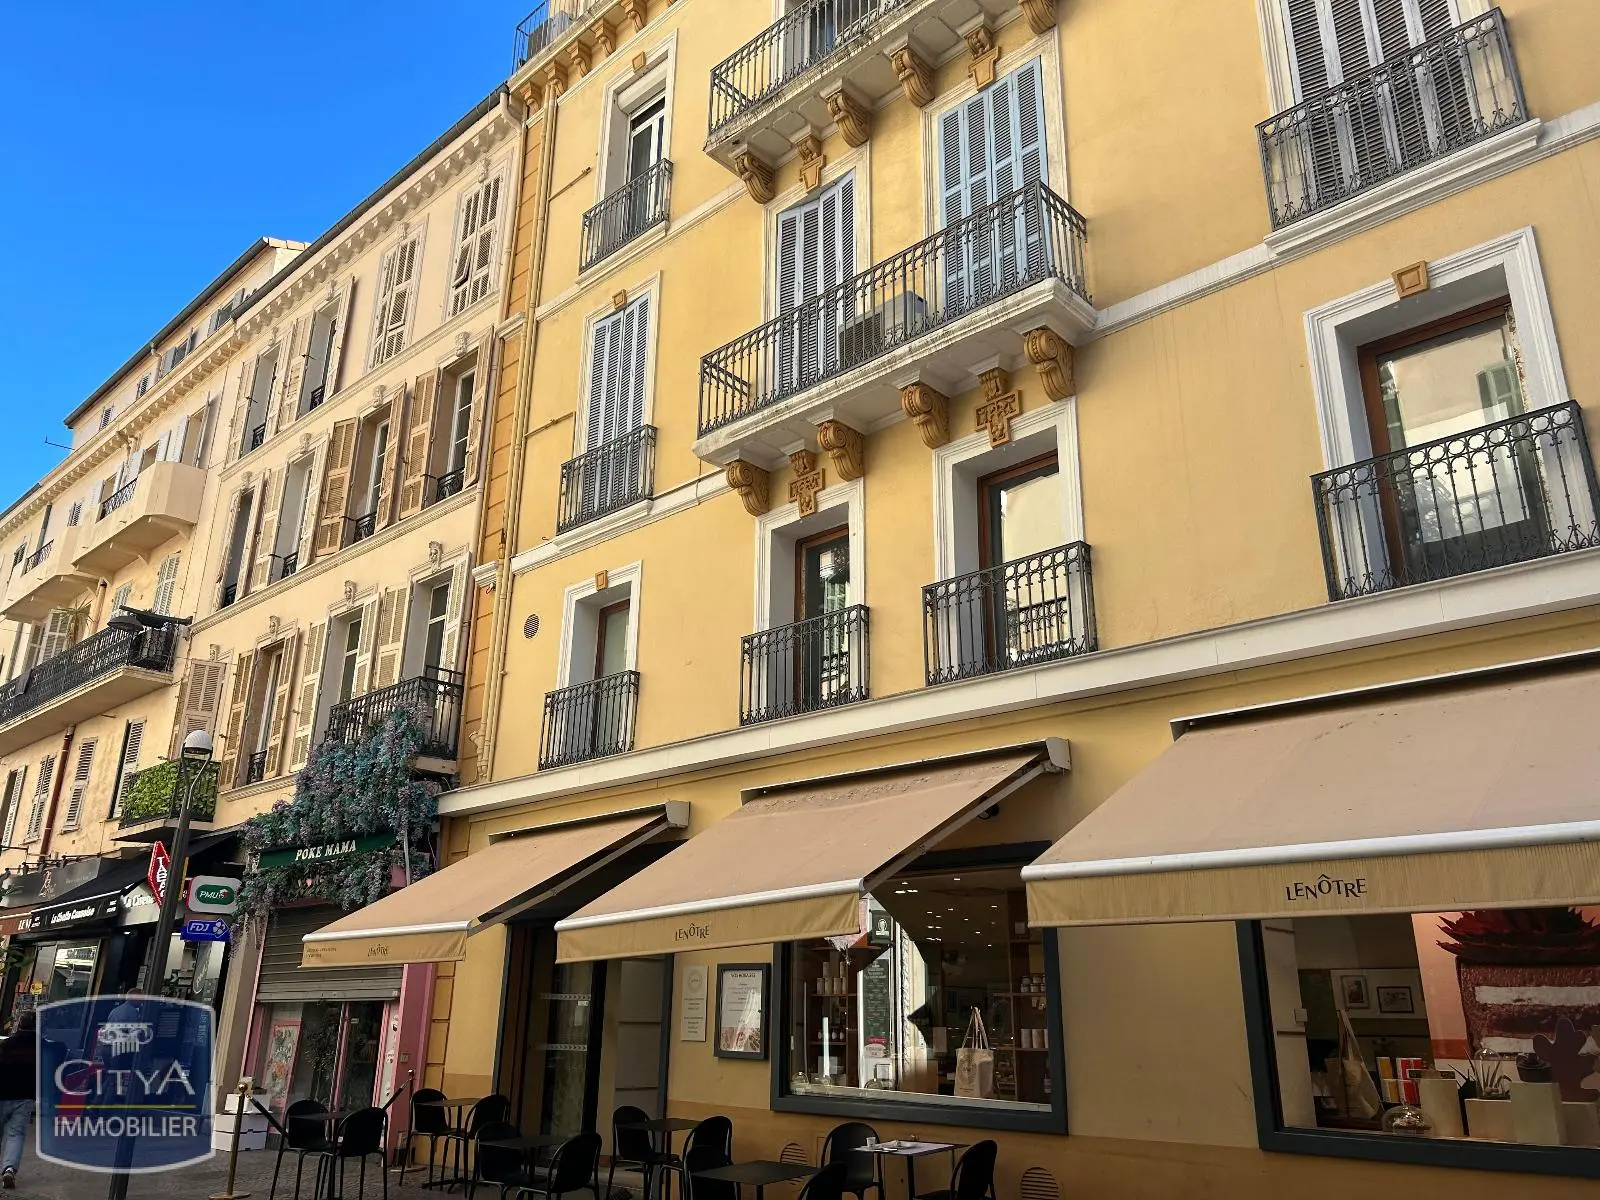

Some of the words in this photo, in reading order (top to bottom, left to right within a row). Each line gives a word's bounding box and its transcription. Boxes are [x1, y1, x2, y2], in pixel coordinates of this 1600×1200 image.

[295, 846, 323, 861] POKE
[324, 840, 356, 857] MAMA
[199, 890, 219, 899] PMU
[1285, 873, 1368, 901] LENÔTRE
[189, 923, 210, 932] FDJ
[675, 922, 710, 941] LENÔTRE
